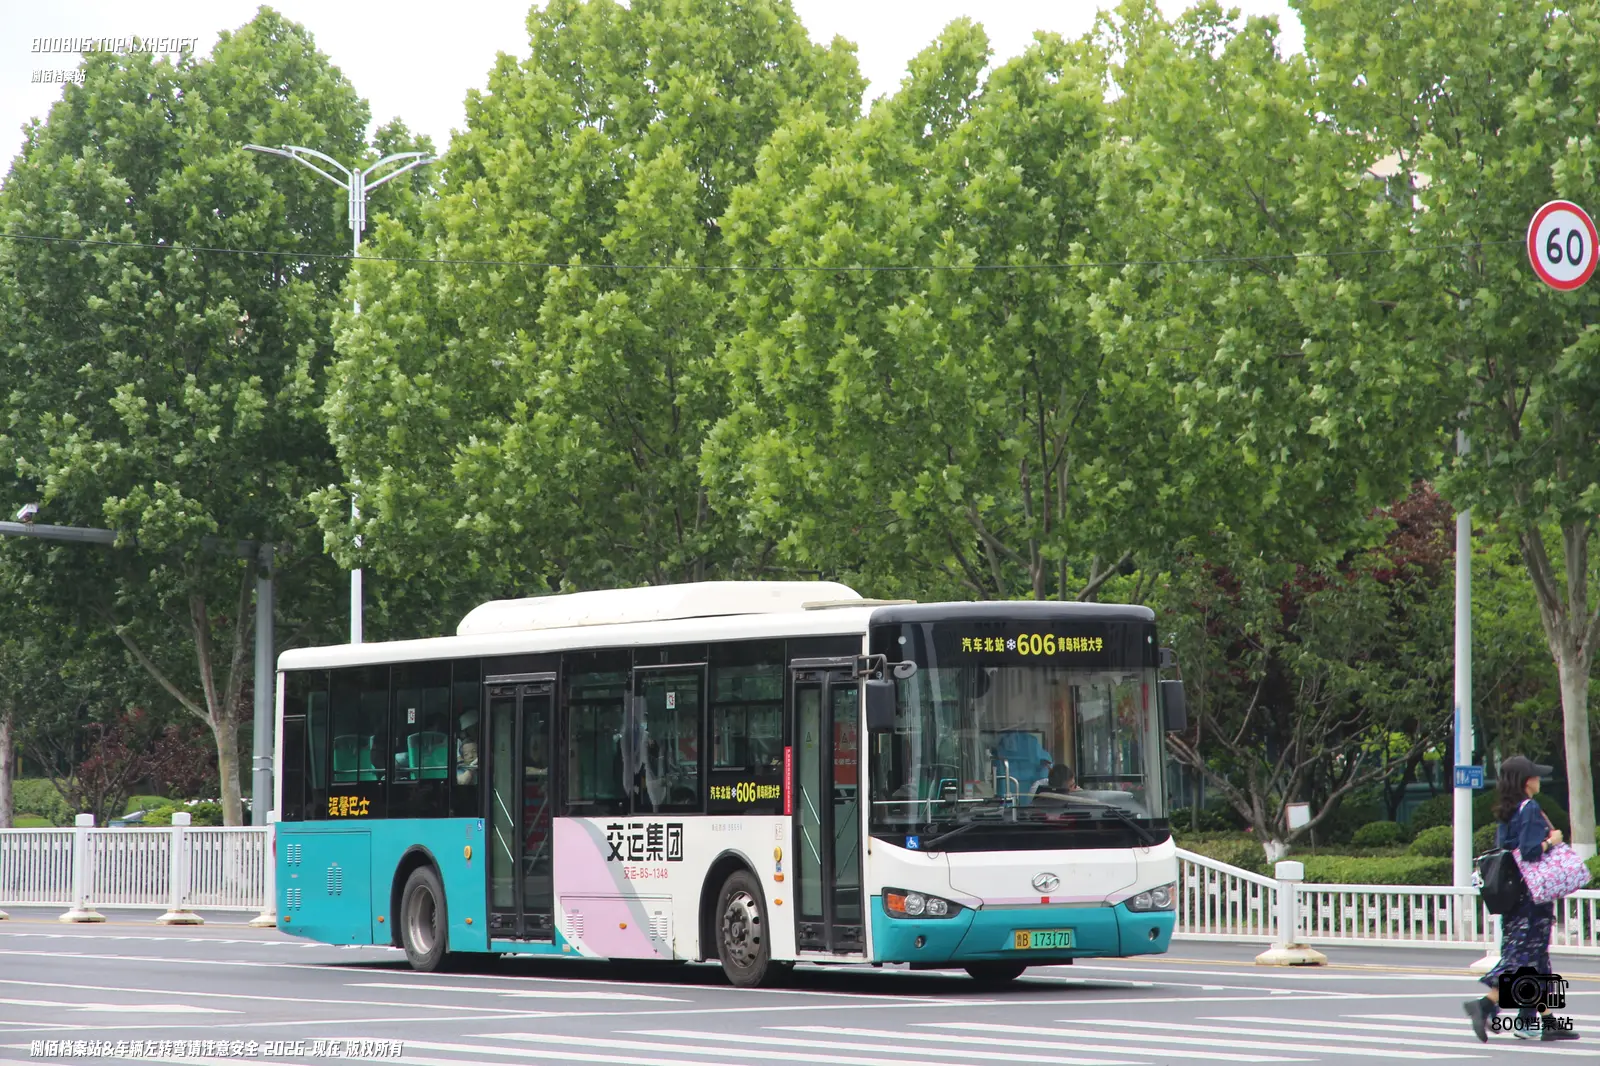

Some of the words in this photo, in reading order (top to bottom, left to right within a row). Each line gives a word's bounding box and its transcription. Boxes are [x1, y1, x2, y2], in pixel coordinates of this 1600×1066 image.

[1546, 227, 1584, 267] 60
[962, 637, 1005, 652] 汽车北站
[1017, 633, 1056, 655] 606
[1058, 637, 1104, 652] 青岛科技大学
[710, 785, 731, 800] 汽车北站
[736, 782, 756, 802] 606
[607, 823, 683, 861] 交运集团
[624, 866, 668, 879] 交运-BS-1348
